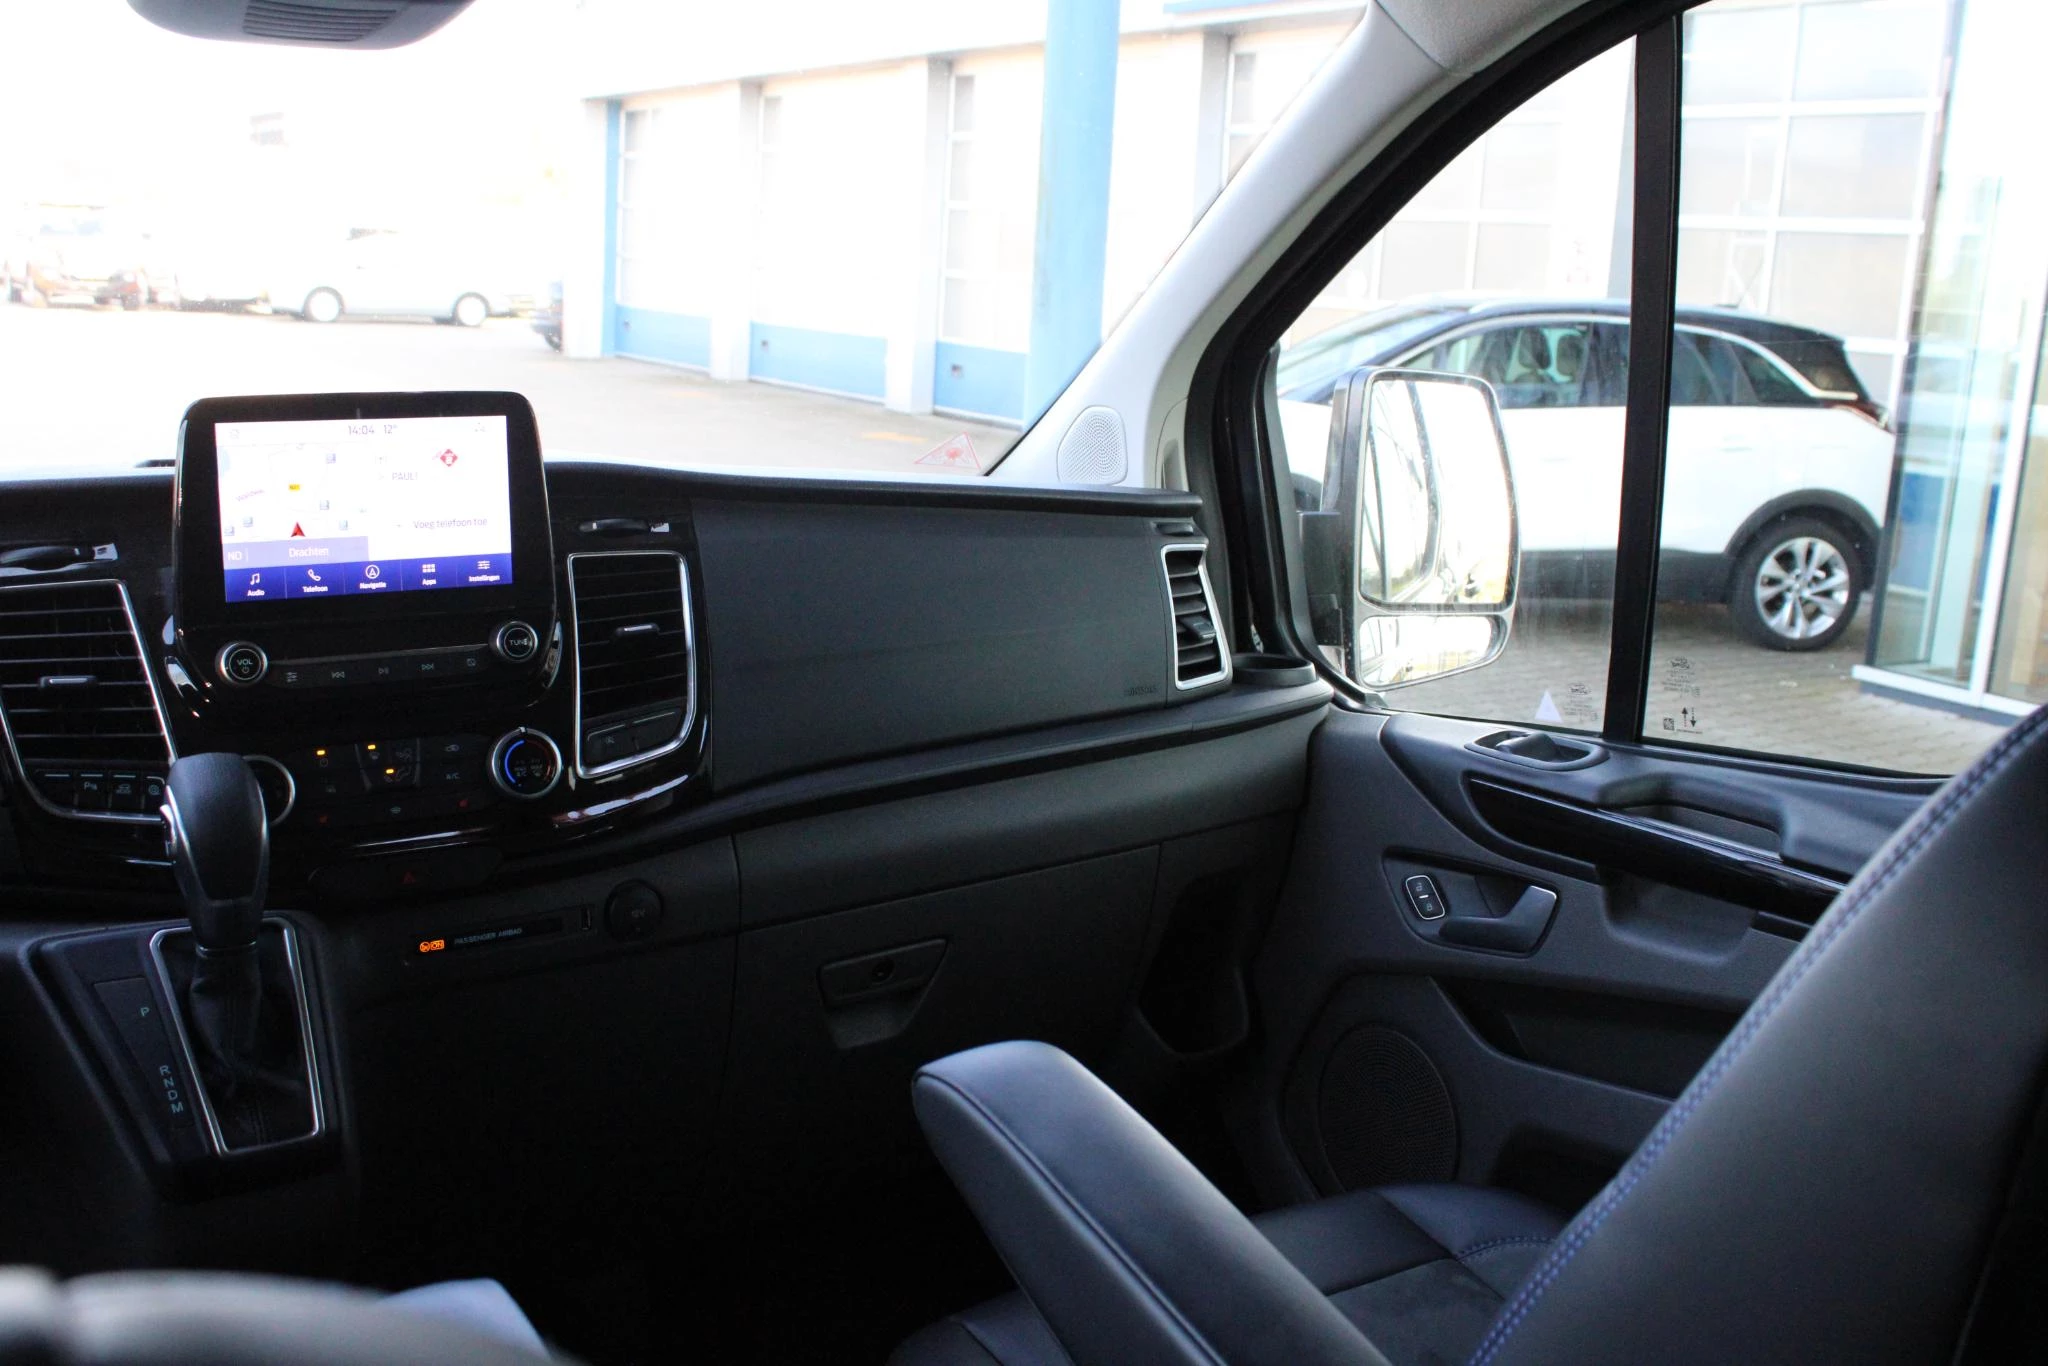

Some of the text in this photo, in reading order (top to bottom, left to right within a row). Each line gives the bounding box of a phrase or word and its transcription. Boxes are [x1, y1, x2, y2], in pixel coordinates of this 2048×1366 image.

[348, 424, 375, 435] 14:04
[288, 546, 329, 558] Drachten
[422, 578, 437, 586] Apps
[468, 574, 500, 582] Instellingen
[302, 585, 328, 593] Telefoon
[359, 581, 387, 590] Navigatie
[247, 589, 265, 597] Audio
[236, 658, 253, 666] VOL
[140, 1007, 150, 1016] P
[159, 1065, 171, 1076] R
[163, 1077, 174, 1088] N
[167, 1090, 178, 1100] D
[171, 1102, 183, 1113] M
